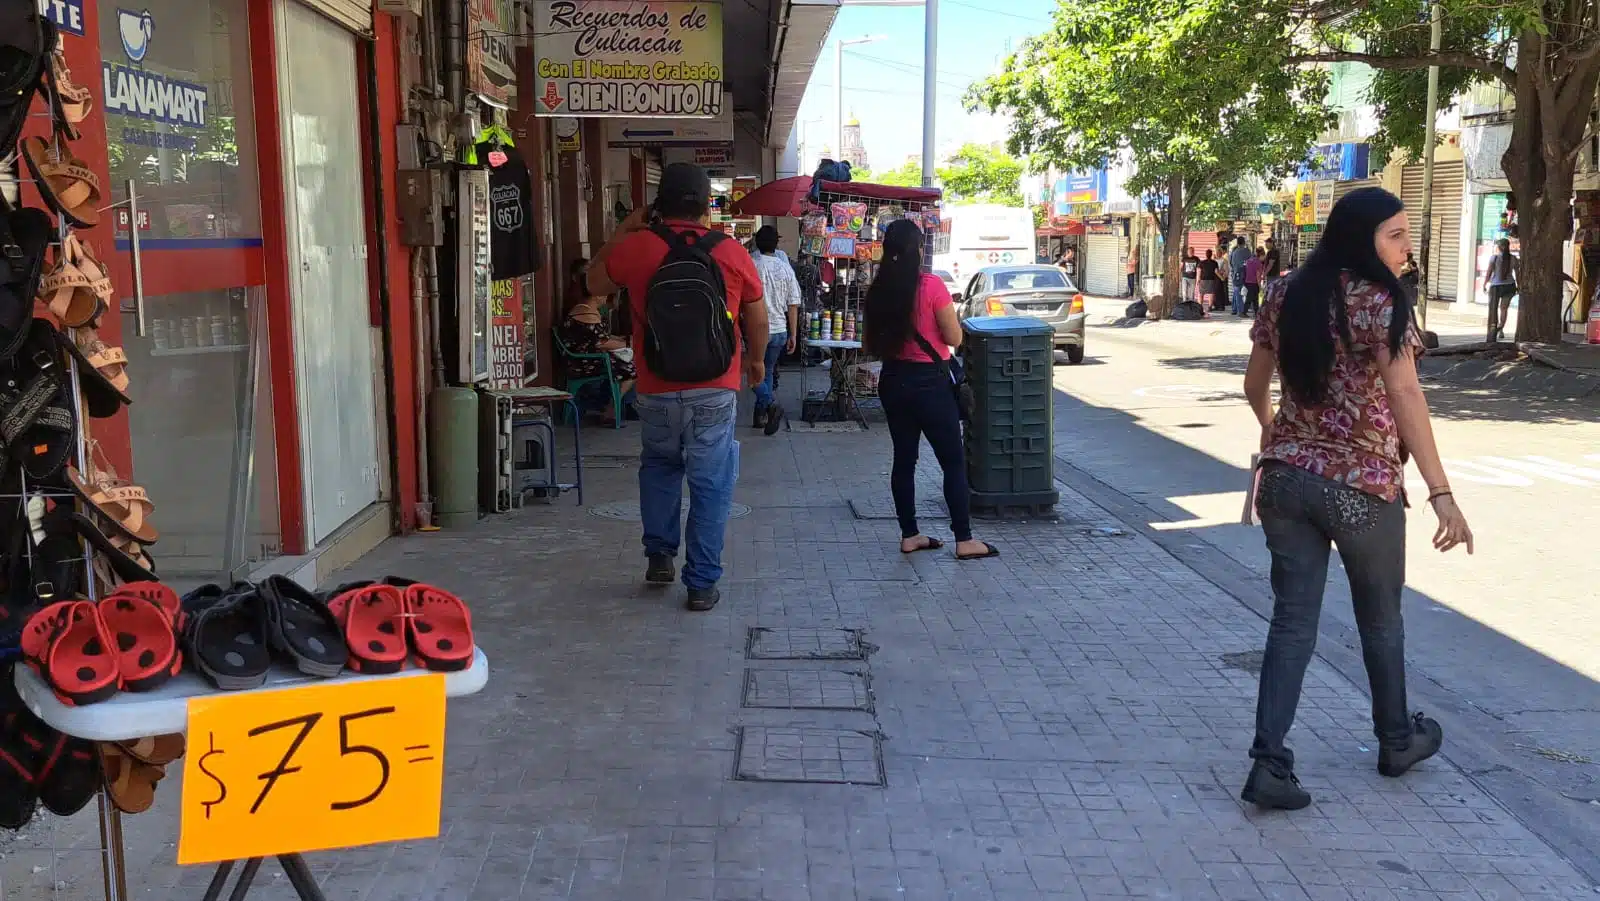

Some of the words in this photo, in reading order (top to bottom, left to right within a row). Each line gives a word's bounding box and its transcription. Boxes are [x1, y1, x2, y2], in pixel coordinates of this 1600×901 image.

[550, 2, 669, 28] Recuerdos
[680, 6, 707, 29] de
[575, 26, 682, 56] Culiacán
[538, 58, 569, 79] Con
[572, 60, 586, 79] El
[590, 60, 650, 79] Nombre
[653, 61, 720, 80] Grabado
[103, 67, 207, 125] LANAMART
[568, 82, 617, 112] BIEN
[497, 206, 519, 226] 667
